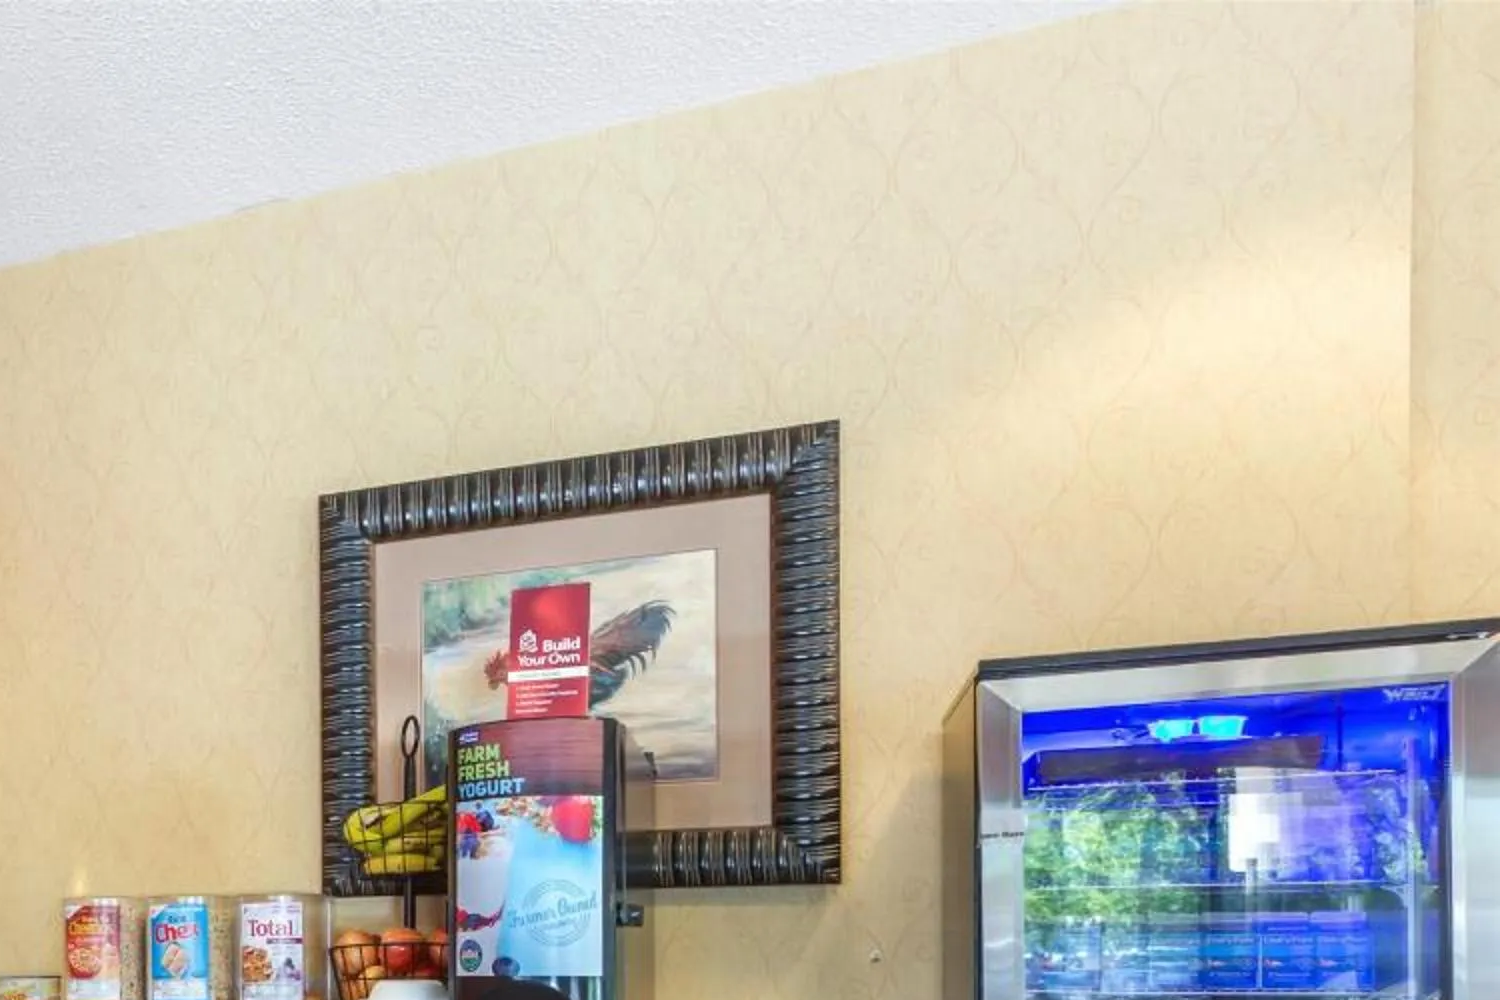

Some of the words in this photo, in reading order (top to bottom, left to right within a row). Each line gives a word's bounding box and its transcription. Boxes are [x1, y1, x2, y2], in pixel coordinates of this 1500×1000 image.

[542, 636, 581, 653] Build
[517, 655, 546, 667] Your
[548, 652, 581, 665] Own
[457, 743, 500, 765] FARM
[457, 760, 509, 782] FRESH
[457, 777, 525, 799] YOGURT
[247, 919, 293, 937] Total
